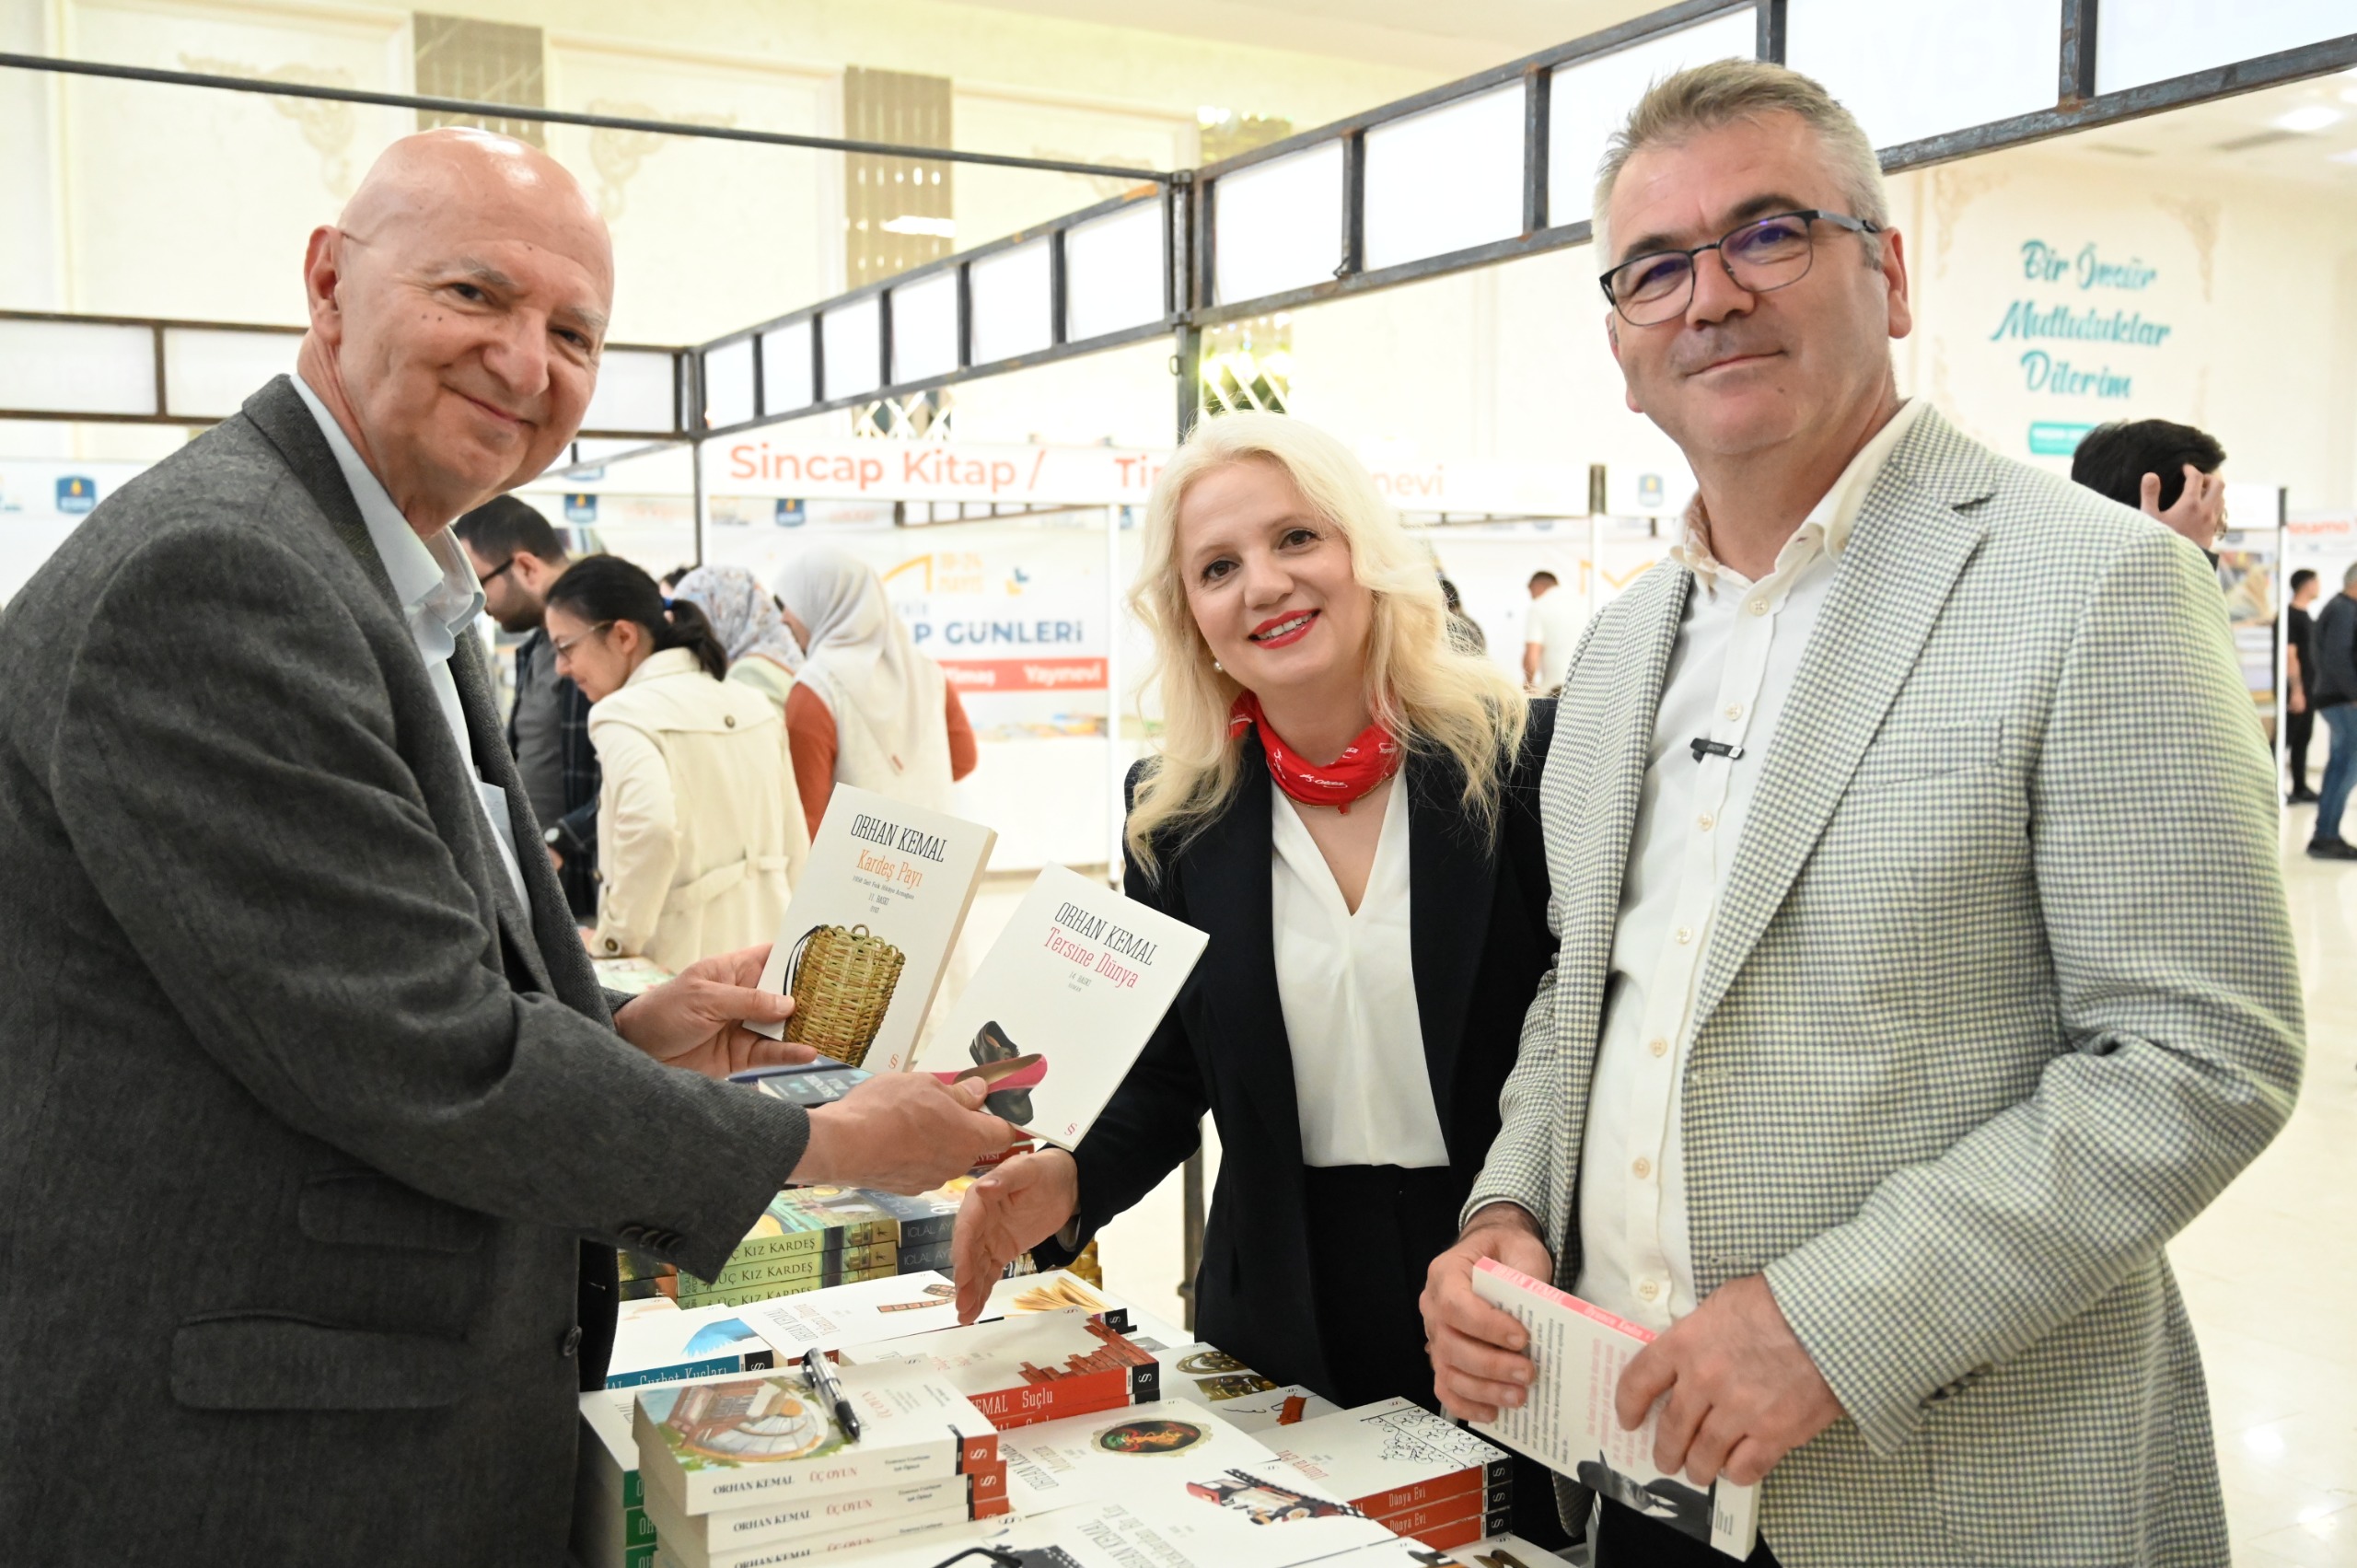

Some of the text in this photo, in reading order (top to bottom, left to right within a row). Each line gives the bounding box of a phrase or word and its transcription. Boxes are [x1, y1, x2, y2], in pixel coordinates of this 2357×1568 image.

[2021, 239, 2069, 281] Bir
[2021, 350, 2132, 399] Dilerim
[729, 443, 884, 490] Sincap
[903, 448, 1016, 493] Kitap
[851, 814, 947, 863] ORHAN KEMAL
[855, 849, 923, 888] Kardeş Payı
[1054, 901, 1158, 966] ORHAN KEMAL
[1044, 926, 1139, 989] Tersine Dünya
[743, 1241, 765, 1258] KIZ
[769, 1237, 816, 1255] KARDEŞ
[717, 1260, 814, 1287] ÜÇ KIZ KARDEŞ
[1022, 1388, 1053, 1411] Suçlu
[713, 1467, 858, 1495] ORHAN KEMAL ÜÇ OYUN
[1388, 1486, 1426, 1508] Dünya Evi
[733, 1499, 873, 1532] ORHAN KEMAL ÜÇ OYUN
[1389, 1512, 1427, 1534] Dünya Evi
